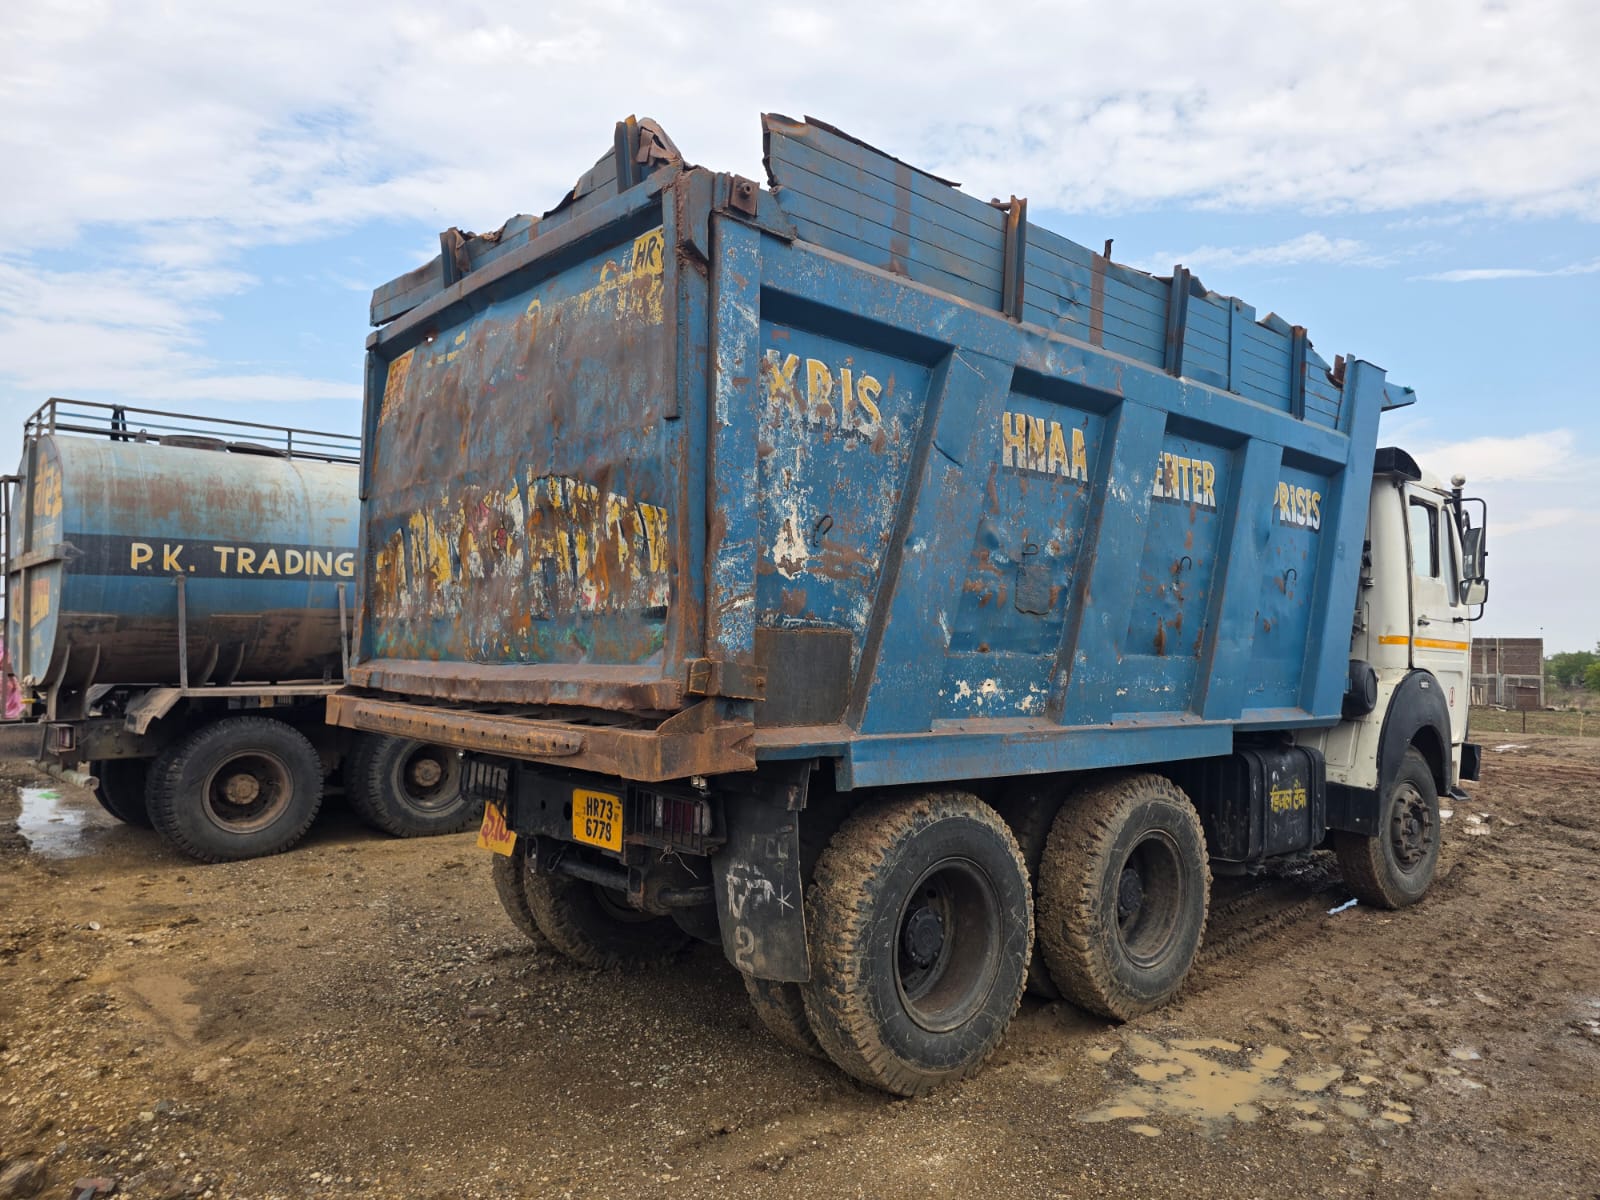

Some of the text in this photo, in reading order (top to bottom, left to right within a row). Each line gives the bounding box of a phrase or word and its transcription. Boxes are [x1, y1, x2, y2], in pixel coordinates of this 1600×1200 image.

[1002, 412, 1089, 482] HNAA
[1152, 450, 1217, 508] ENTER
[1273, 481, 1322, 531] RISES
[213, 546, 355, 577] TRADING
[586, 796, 613, 821] HR73
[585, 818, 612, 842] 6778
